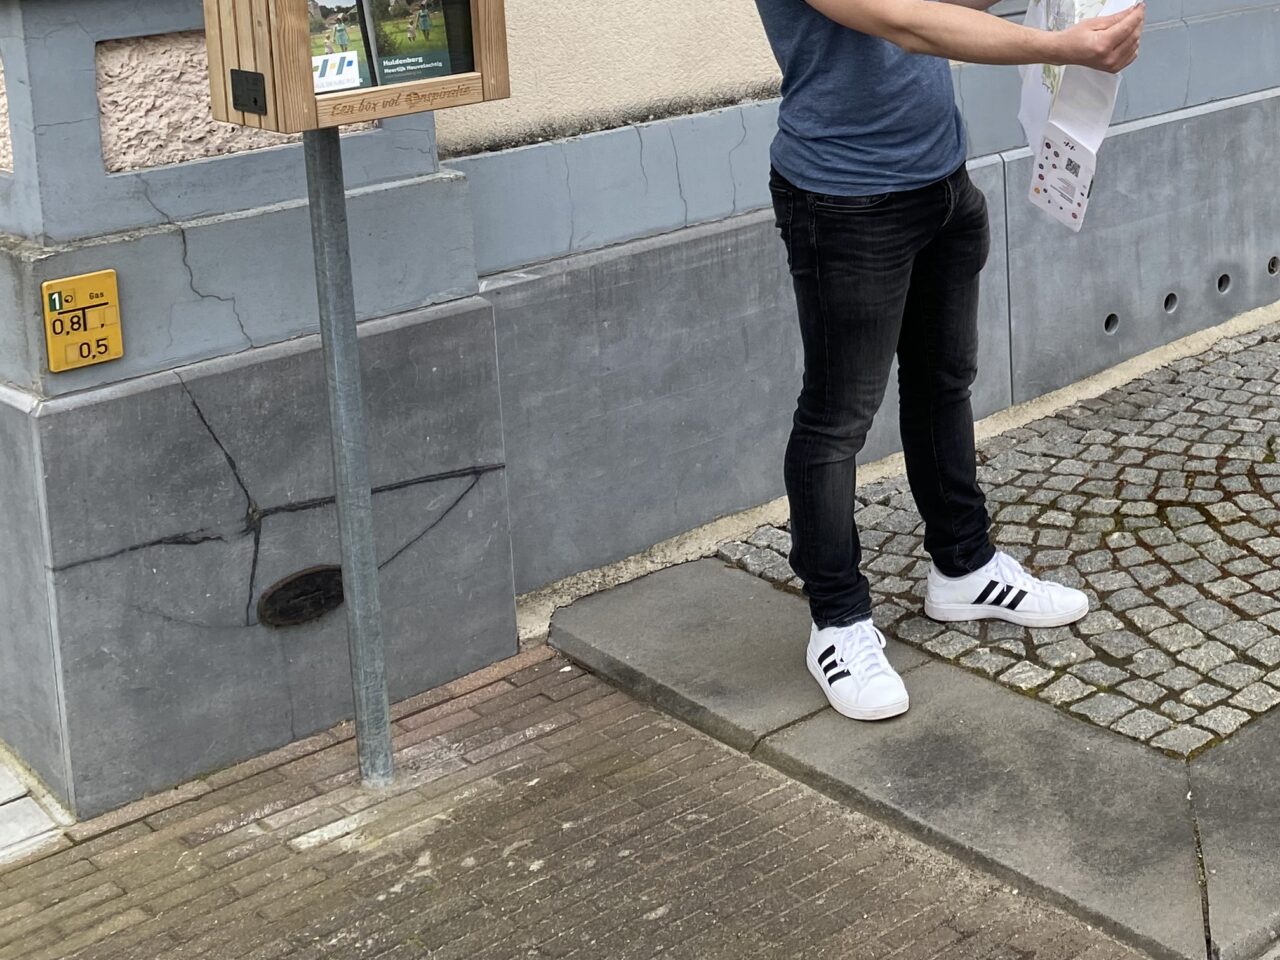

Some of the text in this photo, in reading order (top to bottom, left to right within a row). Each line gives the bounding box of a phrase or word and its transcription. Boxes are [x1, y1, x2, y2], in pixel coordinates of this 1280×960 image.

[330, 103, 355, 117] Een
[359, 97, 379, 113] box
[382, 92, 402, 109] vol
[51, 292, 105, 310] 1 Gas
[52, 314, 81, 336] 0,8
[79, 337, 108, 360] 0,5
